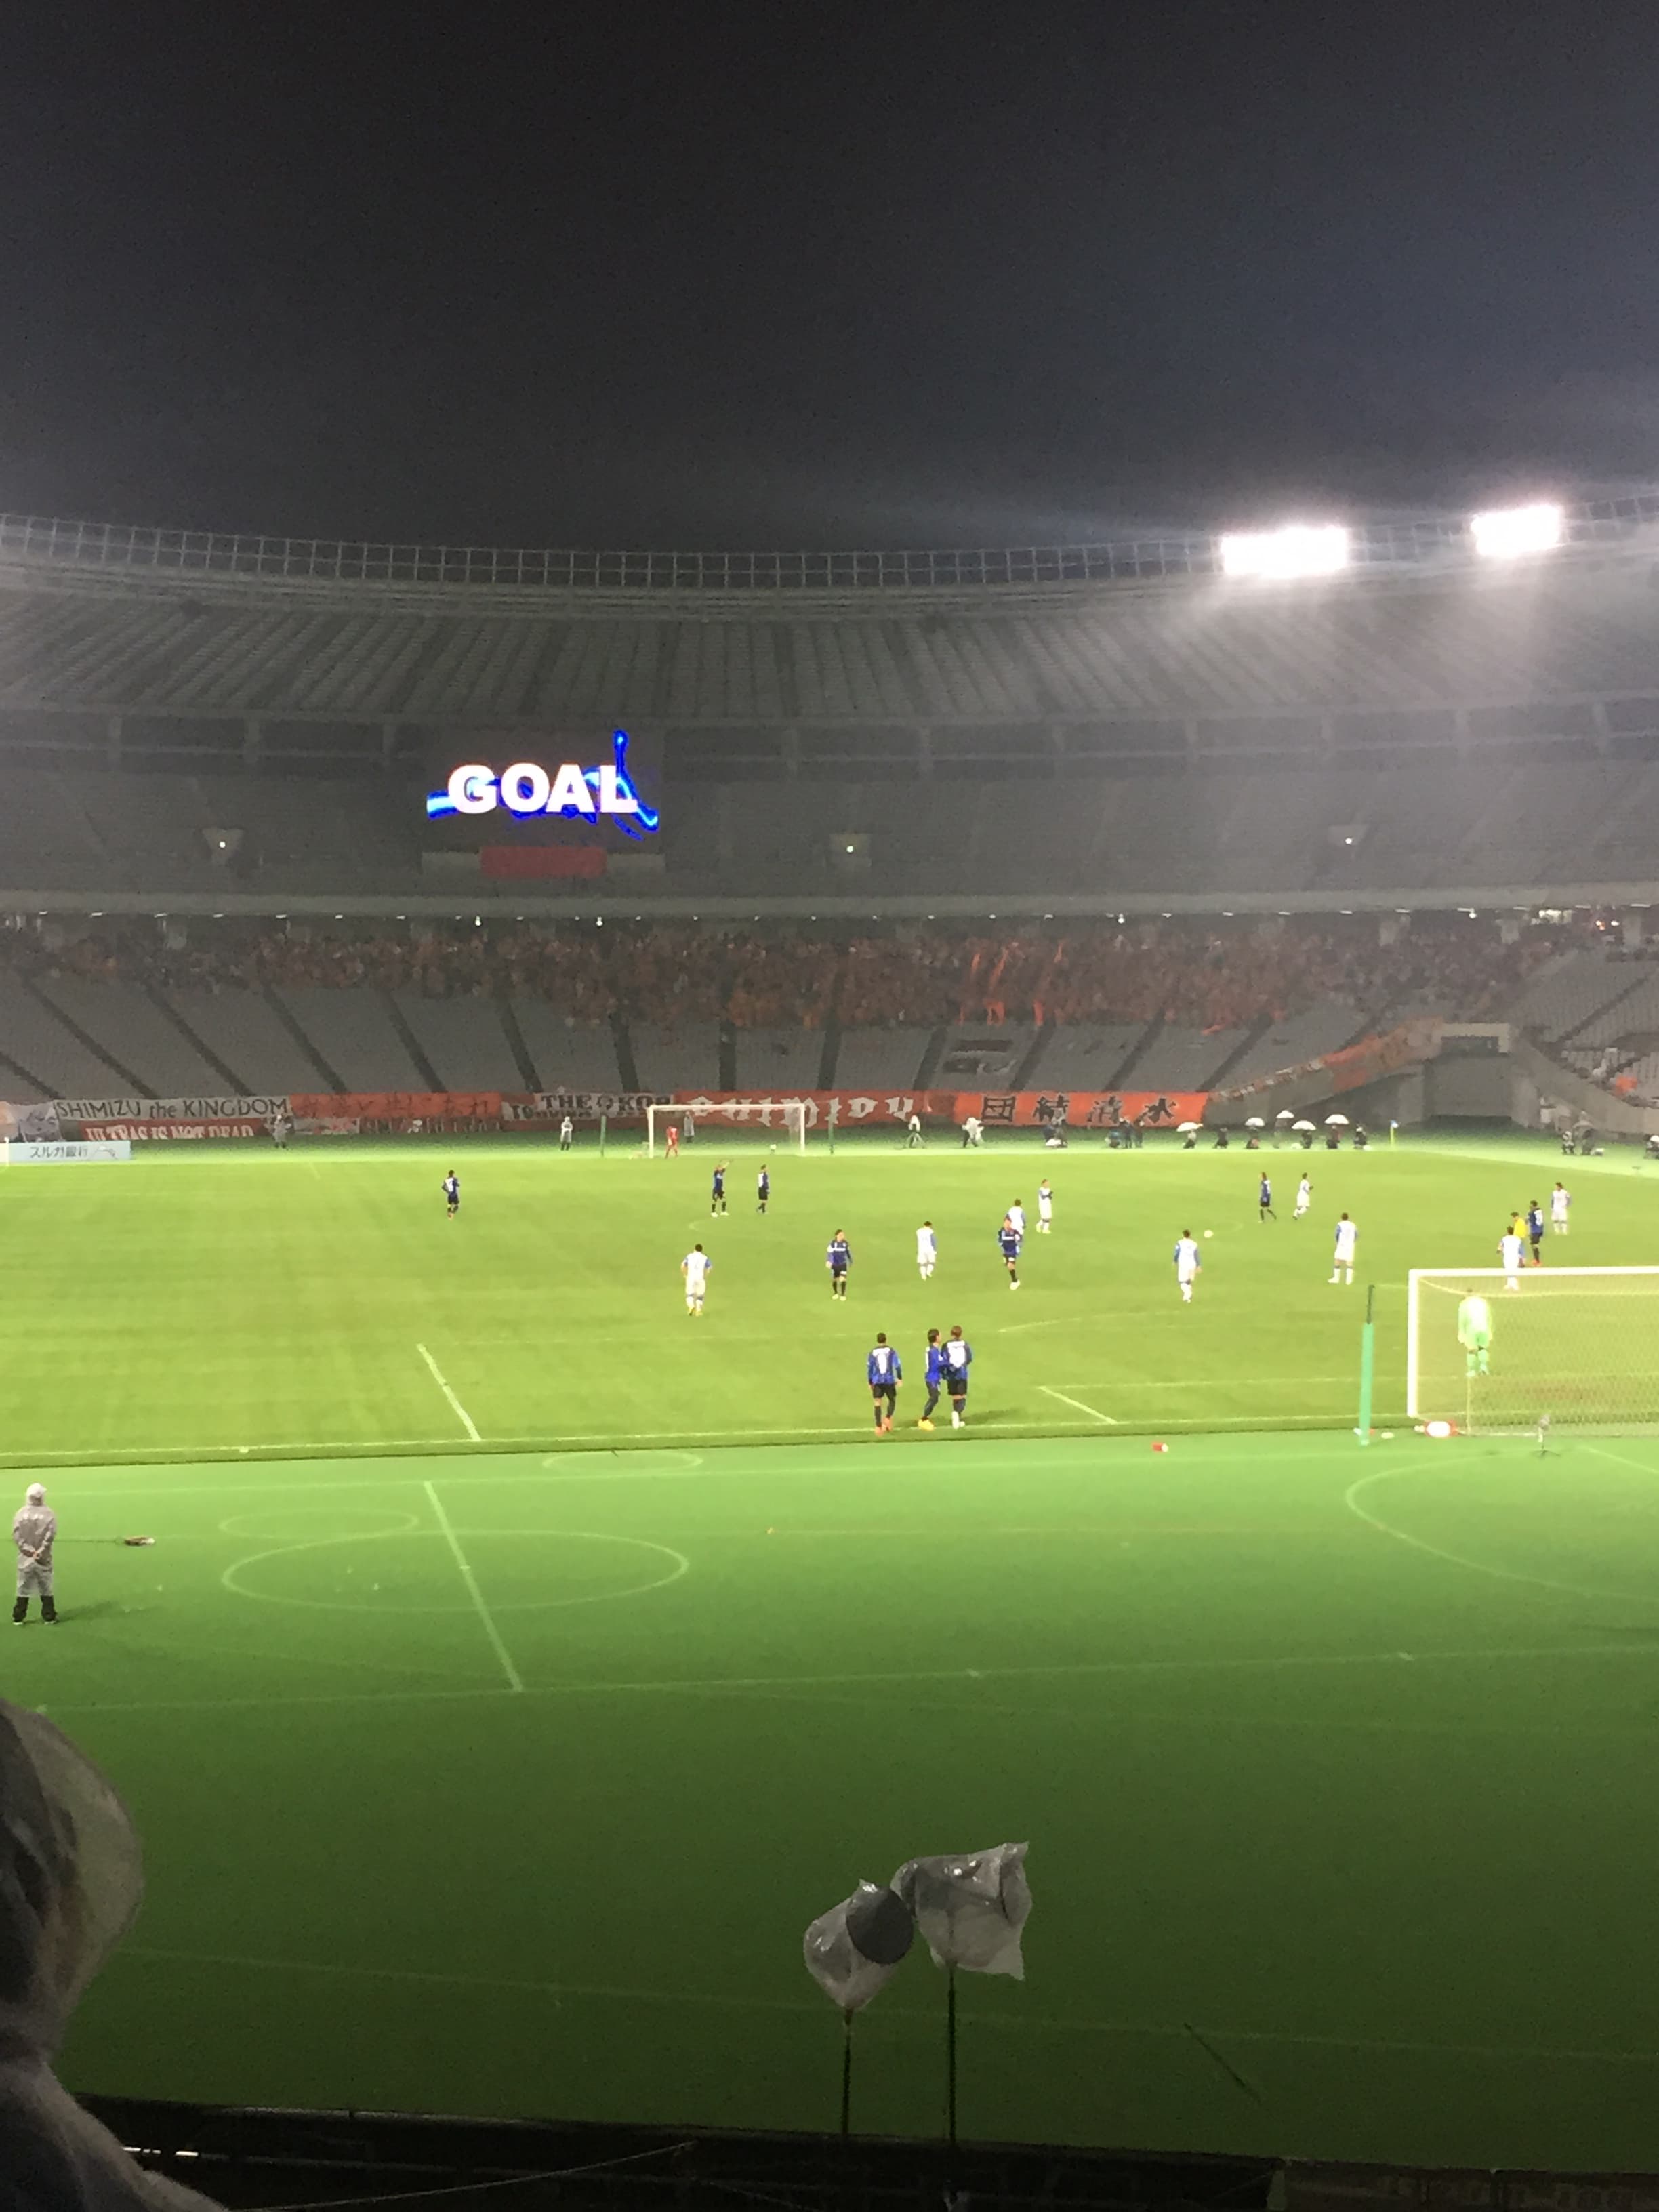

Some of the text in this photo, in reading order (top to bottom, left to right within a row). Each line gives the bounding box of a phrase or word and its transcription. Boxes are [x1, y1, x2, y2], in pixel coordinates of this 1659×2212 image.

[447, 762, 638, 814] GOAL
[56, 1099, 141, 1118] SHIMIZU
[149, 1101, 177, 1118] the
[182, 1097, 288, 1118] KINGDOM
[541, 1094, 592, 1110] THE
[151, 1124, 169, 1140] IS
[170, 1124, 205, 1139] NOT
[208, 1124, 254, 1139] DEAD
